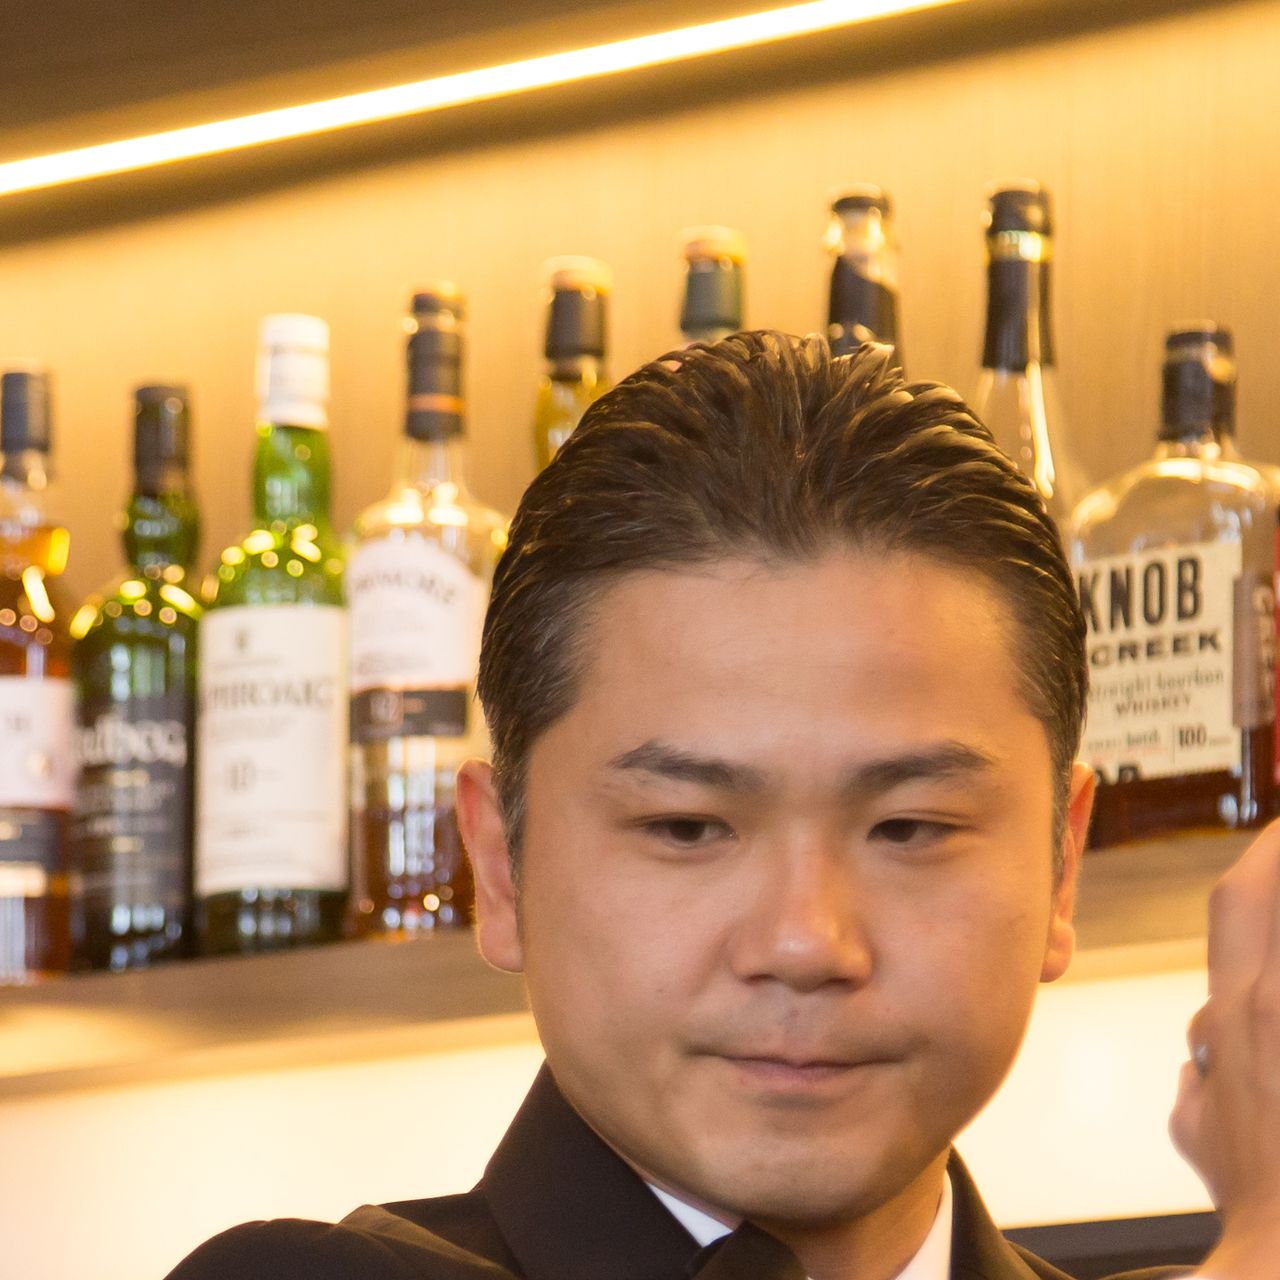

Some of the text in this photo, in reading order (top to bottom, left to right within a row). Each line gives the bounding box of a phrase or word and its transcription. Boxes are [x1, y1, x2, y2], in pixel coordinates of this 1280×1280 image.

[1079, 557, 1201, 632] KNOB
[1091, 631, 1221, 666] CREEK
[1178, 722, 1208, 748] 100
